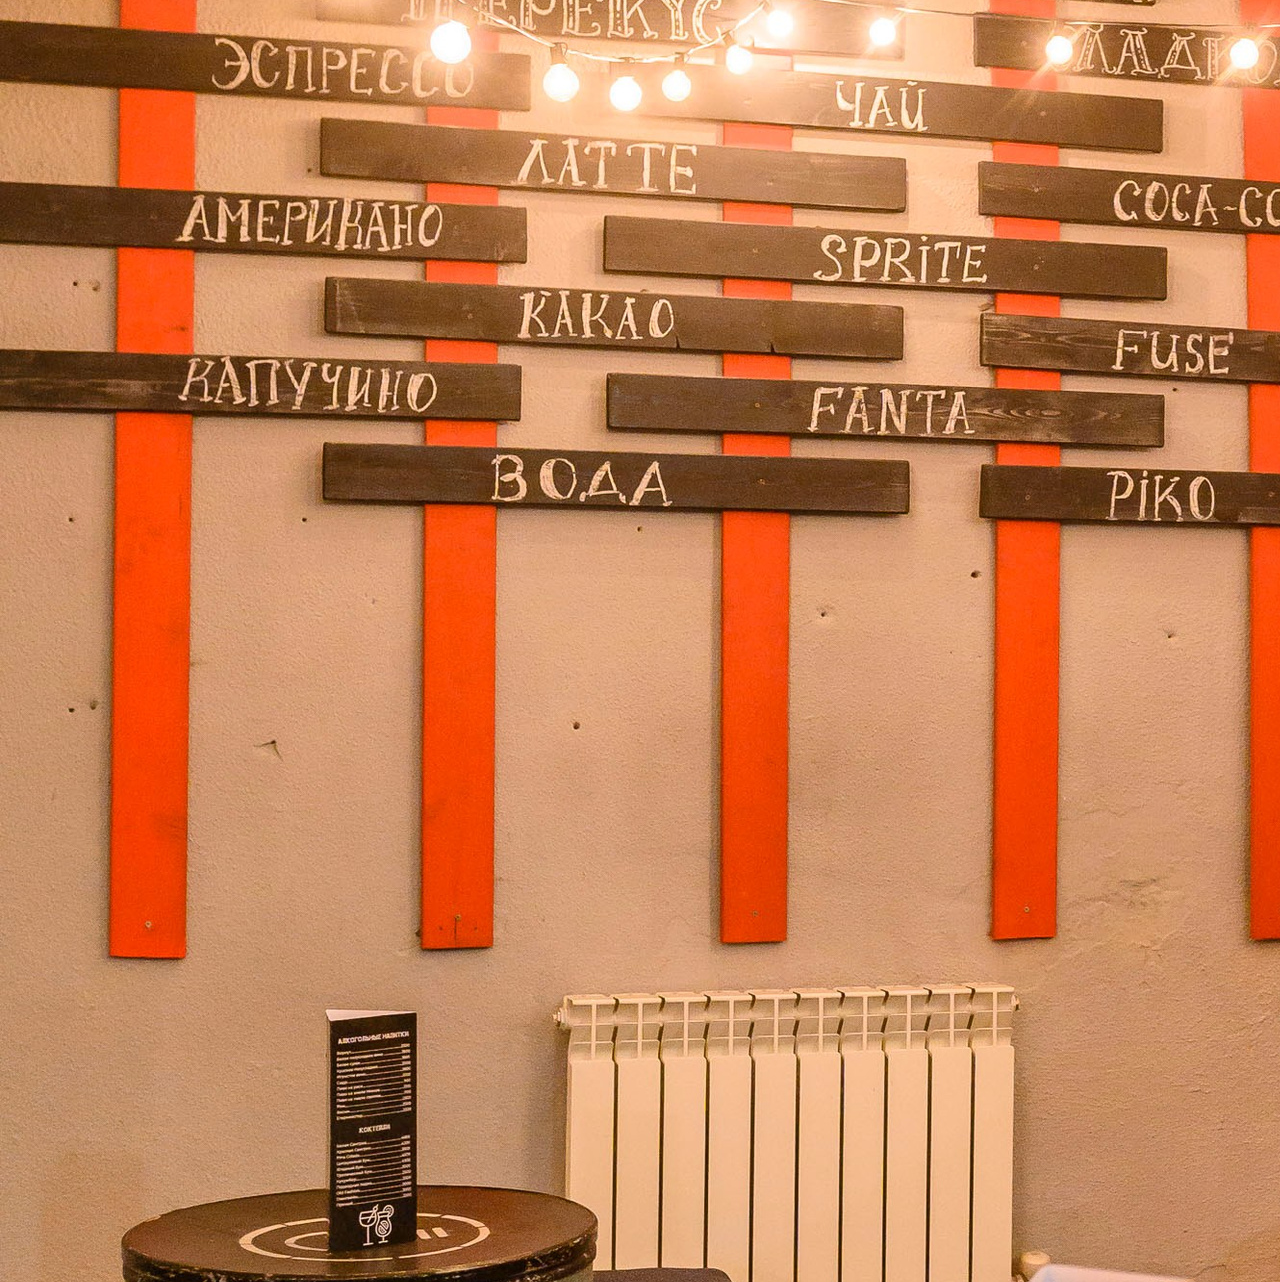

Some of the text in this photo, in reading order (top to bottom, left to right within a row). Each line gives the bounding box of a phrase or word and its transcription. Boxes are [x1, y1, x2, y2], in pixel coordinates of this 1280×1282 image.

[212, 37, 474, 99] ЭСПРЕССО
[834, 79, 929, 132] ЧАЙ
[510, 138, 698, 196] ЛАТТЕ
[176, 194, 445, 252] АМЕРИКАНО
[517, 290, 676, 340] КАКАО
[1110, 328, 1235, 376] FUSE
[178, 356, 438, 413] КАПУЧИНО
[806, 386, 975, 435] FANTA
[490, 453, 674, 507] ВОДА
